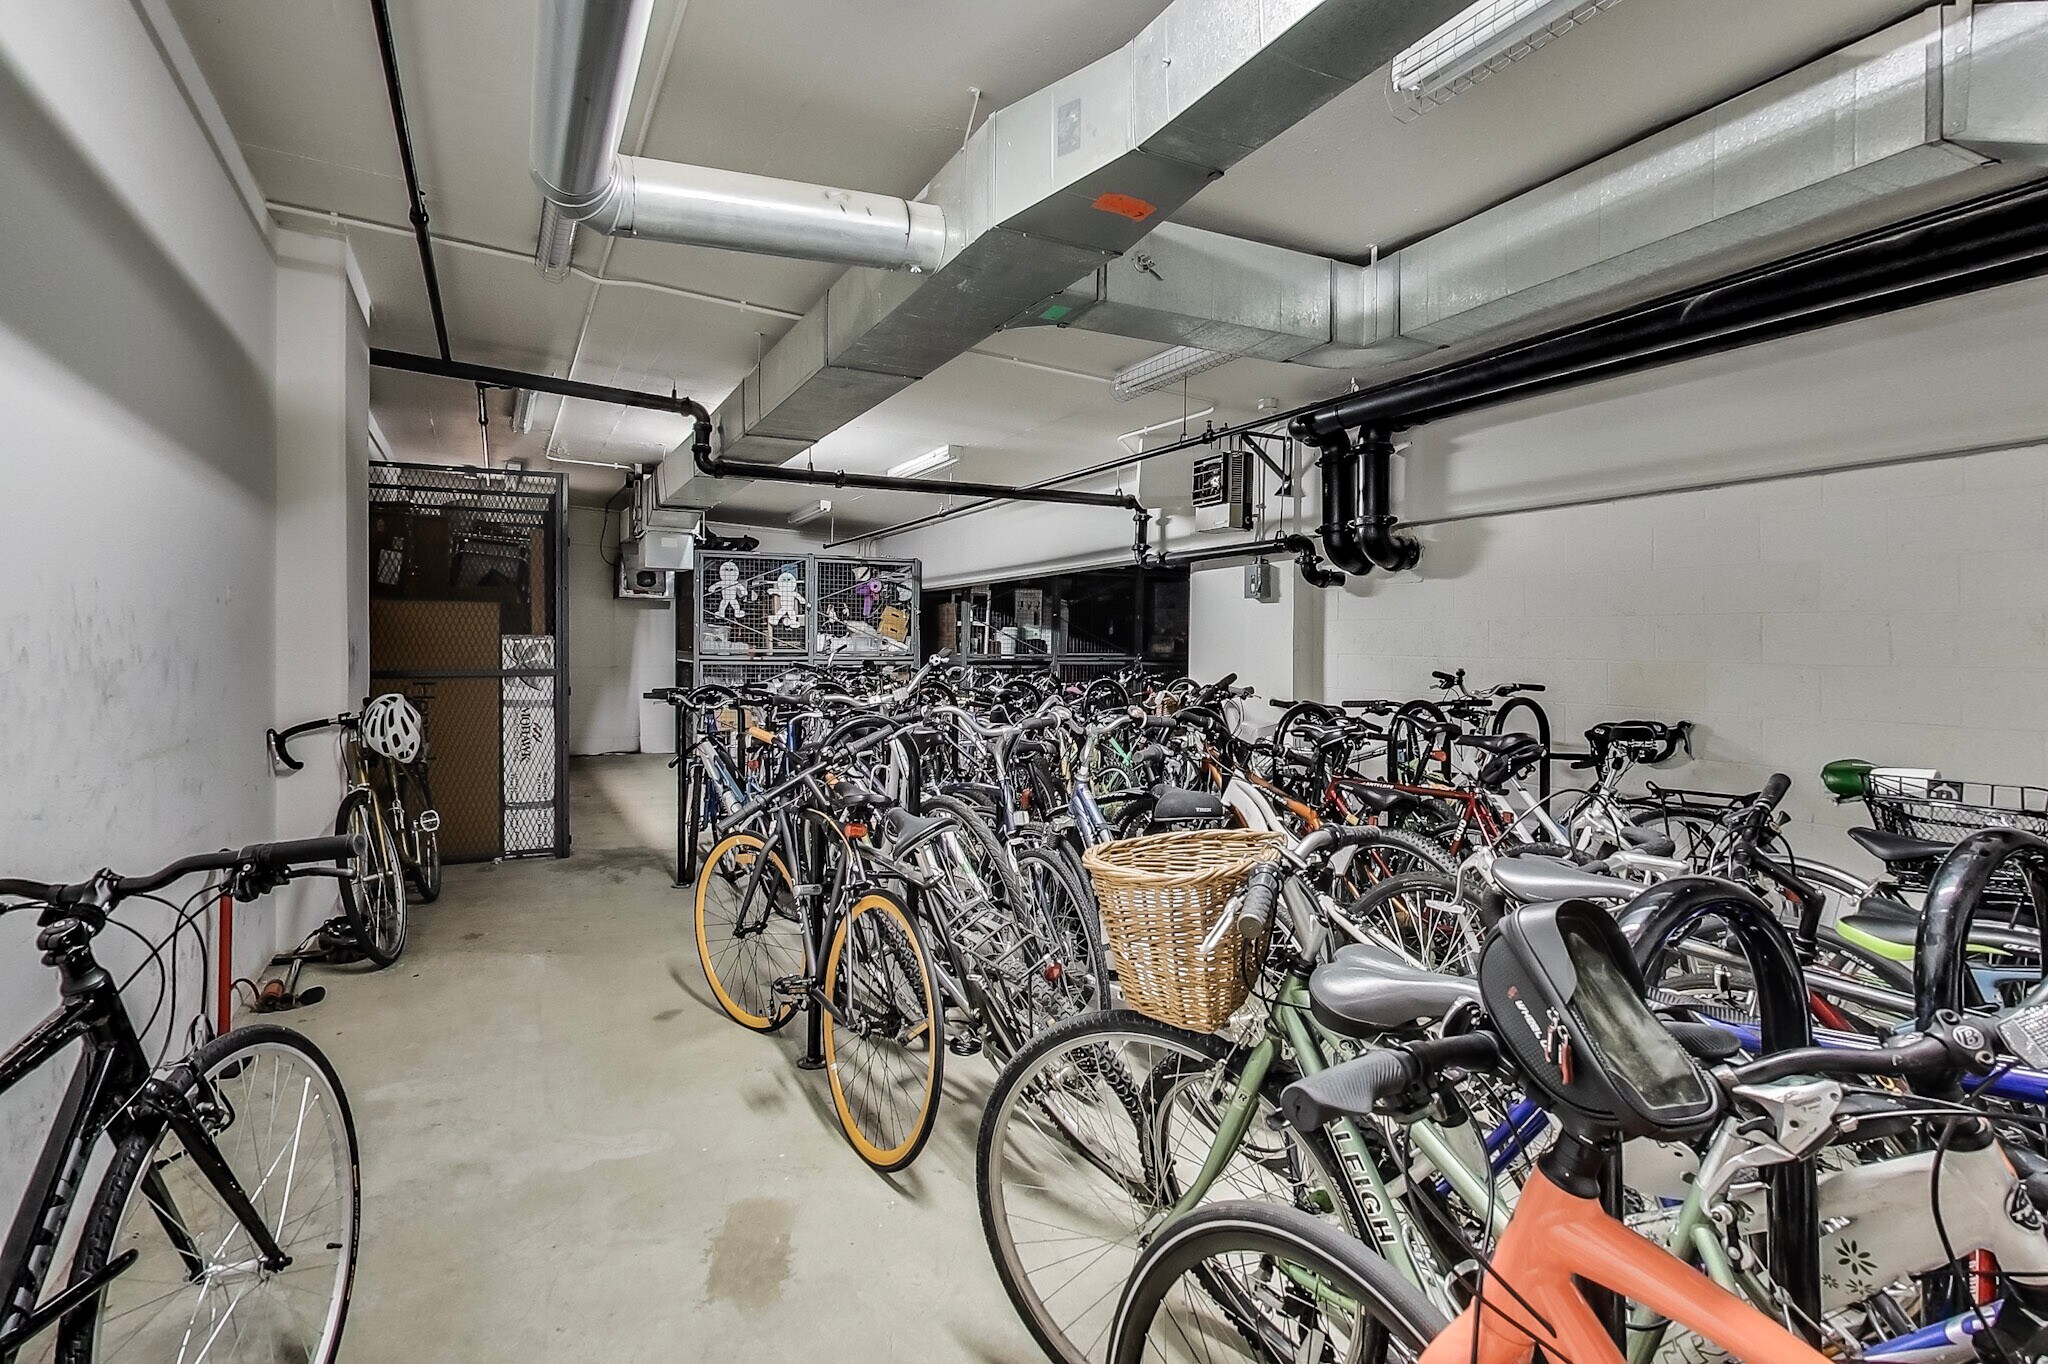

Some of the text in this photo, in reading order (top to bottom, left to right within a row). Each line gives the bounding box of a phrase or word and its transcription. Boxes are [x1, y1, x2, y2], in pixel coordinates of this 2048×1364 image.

[520, 706, 532, 762] MOHAWK
[1364, 781, 1395, 790] ANTELOPE
[1514, 1000, 1543, 1040] WHEEL
